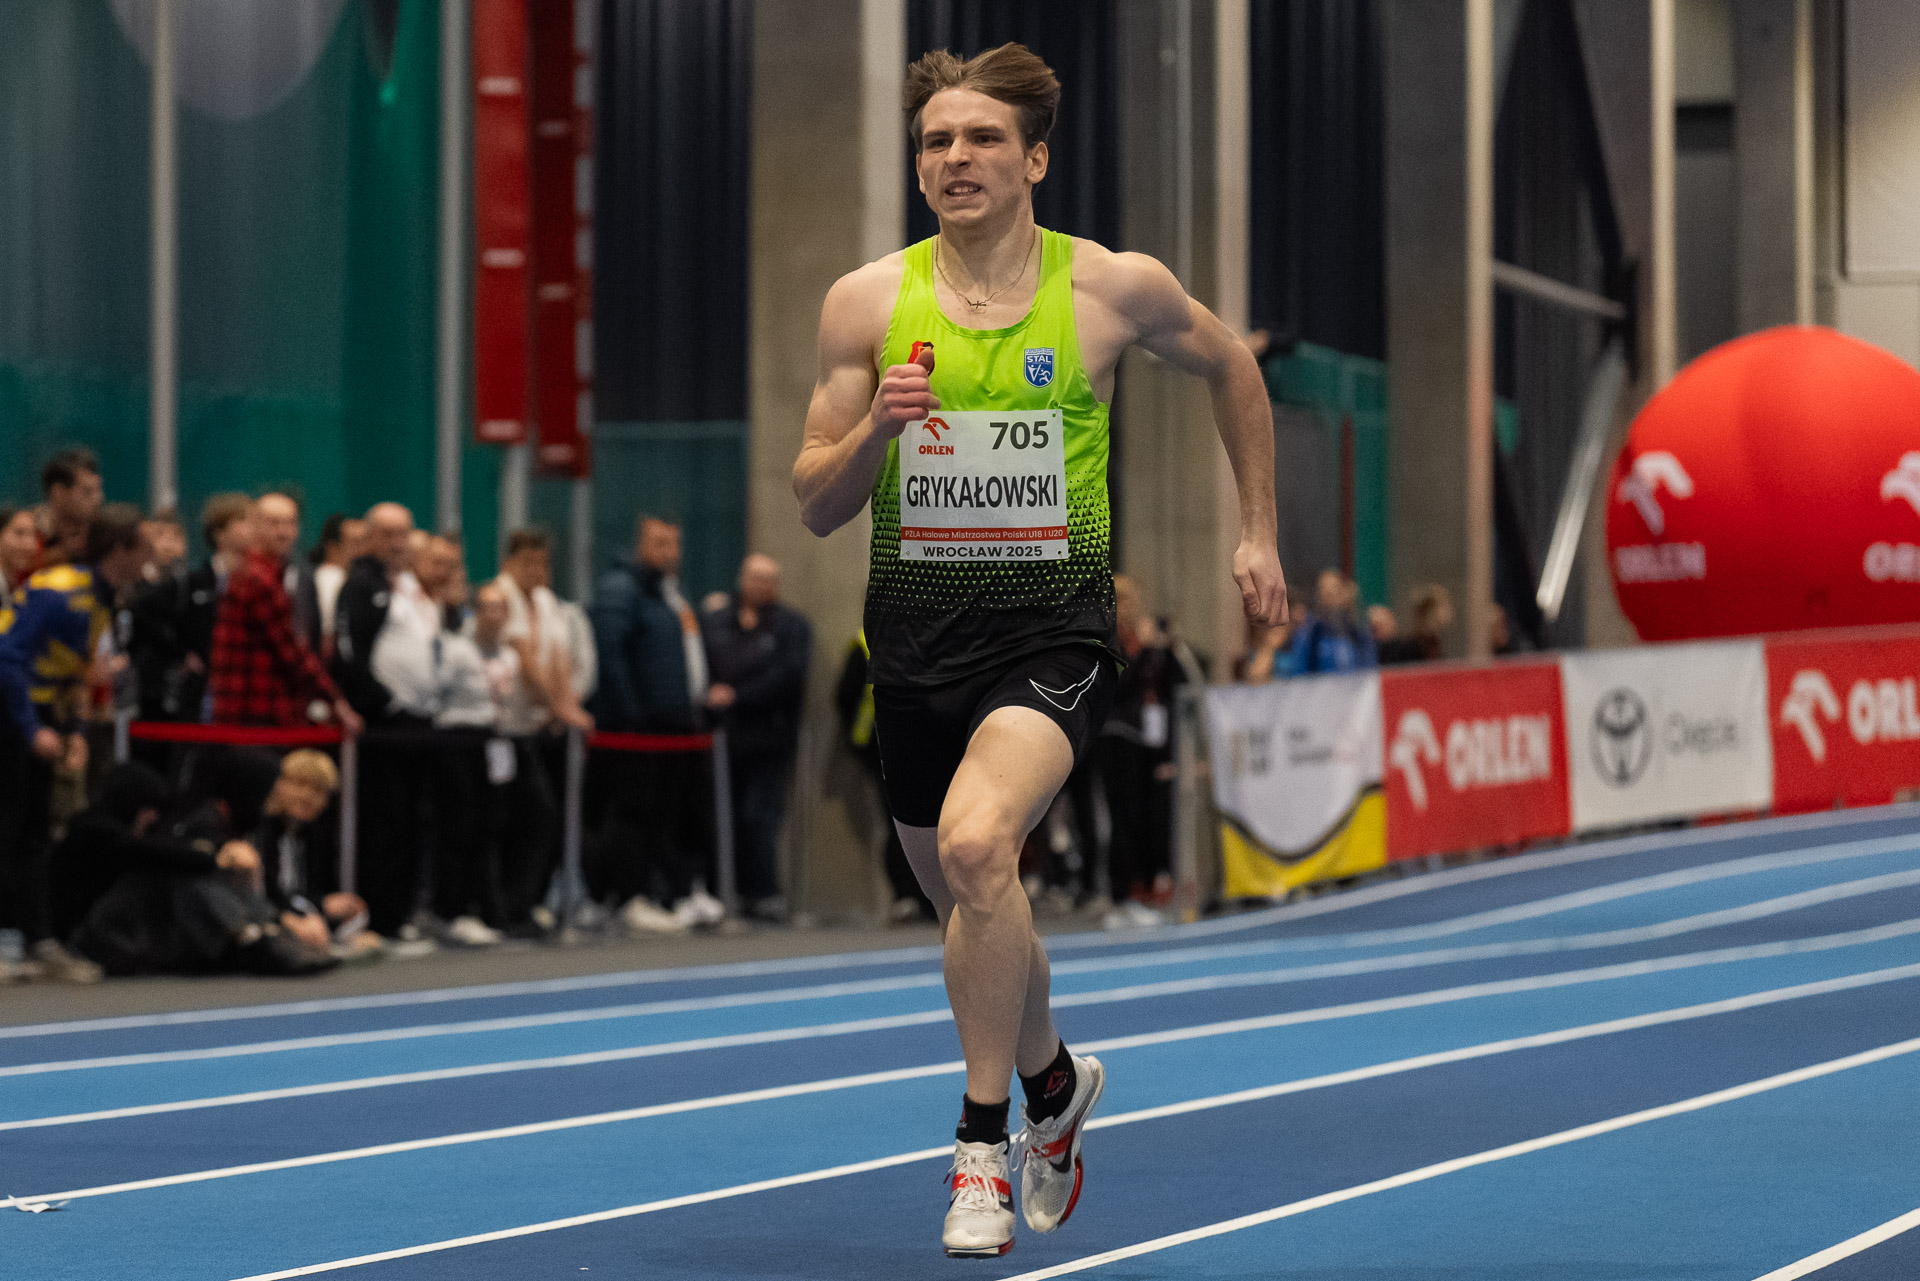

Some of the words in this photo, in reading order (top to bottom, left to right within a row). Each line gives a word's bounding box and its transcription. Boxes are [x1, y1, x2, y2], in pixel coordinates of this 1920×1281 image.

[1026, 355, 1051, 363] STAL
[989, 420, 1049, 450] 705
[918, 444, 954, 455] ORLEN
[906, 474, 1058, 508] GRYKAŁOWSKI
[905, 530, 921, 538] PZLA
[922, 531, 950, 539] Halowe
[951, 531, 1001, 539] Mistrzostwa
[1002, 530, 1027, 539] Polski
[1028, 530, 1043, 538] U18
[1048, 529, 1064, 537] U20
[923, 546, 1003, 557] WROCŁAW
[1006, 545, 1043, 557] 2025
